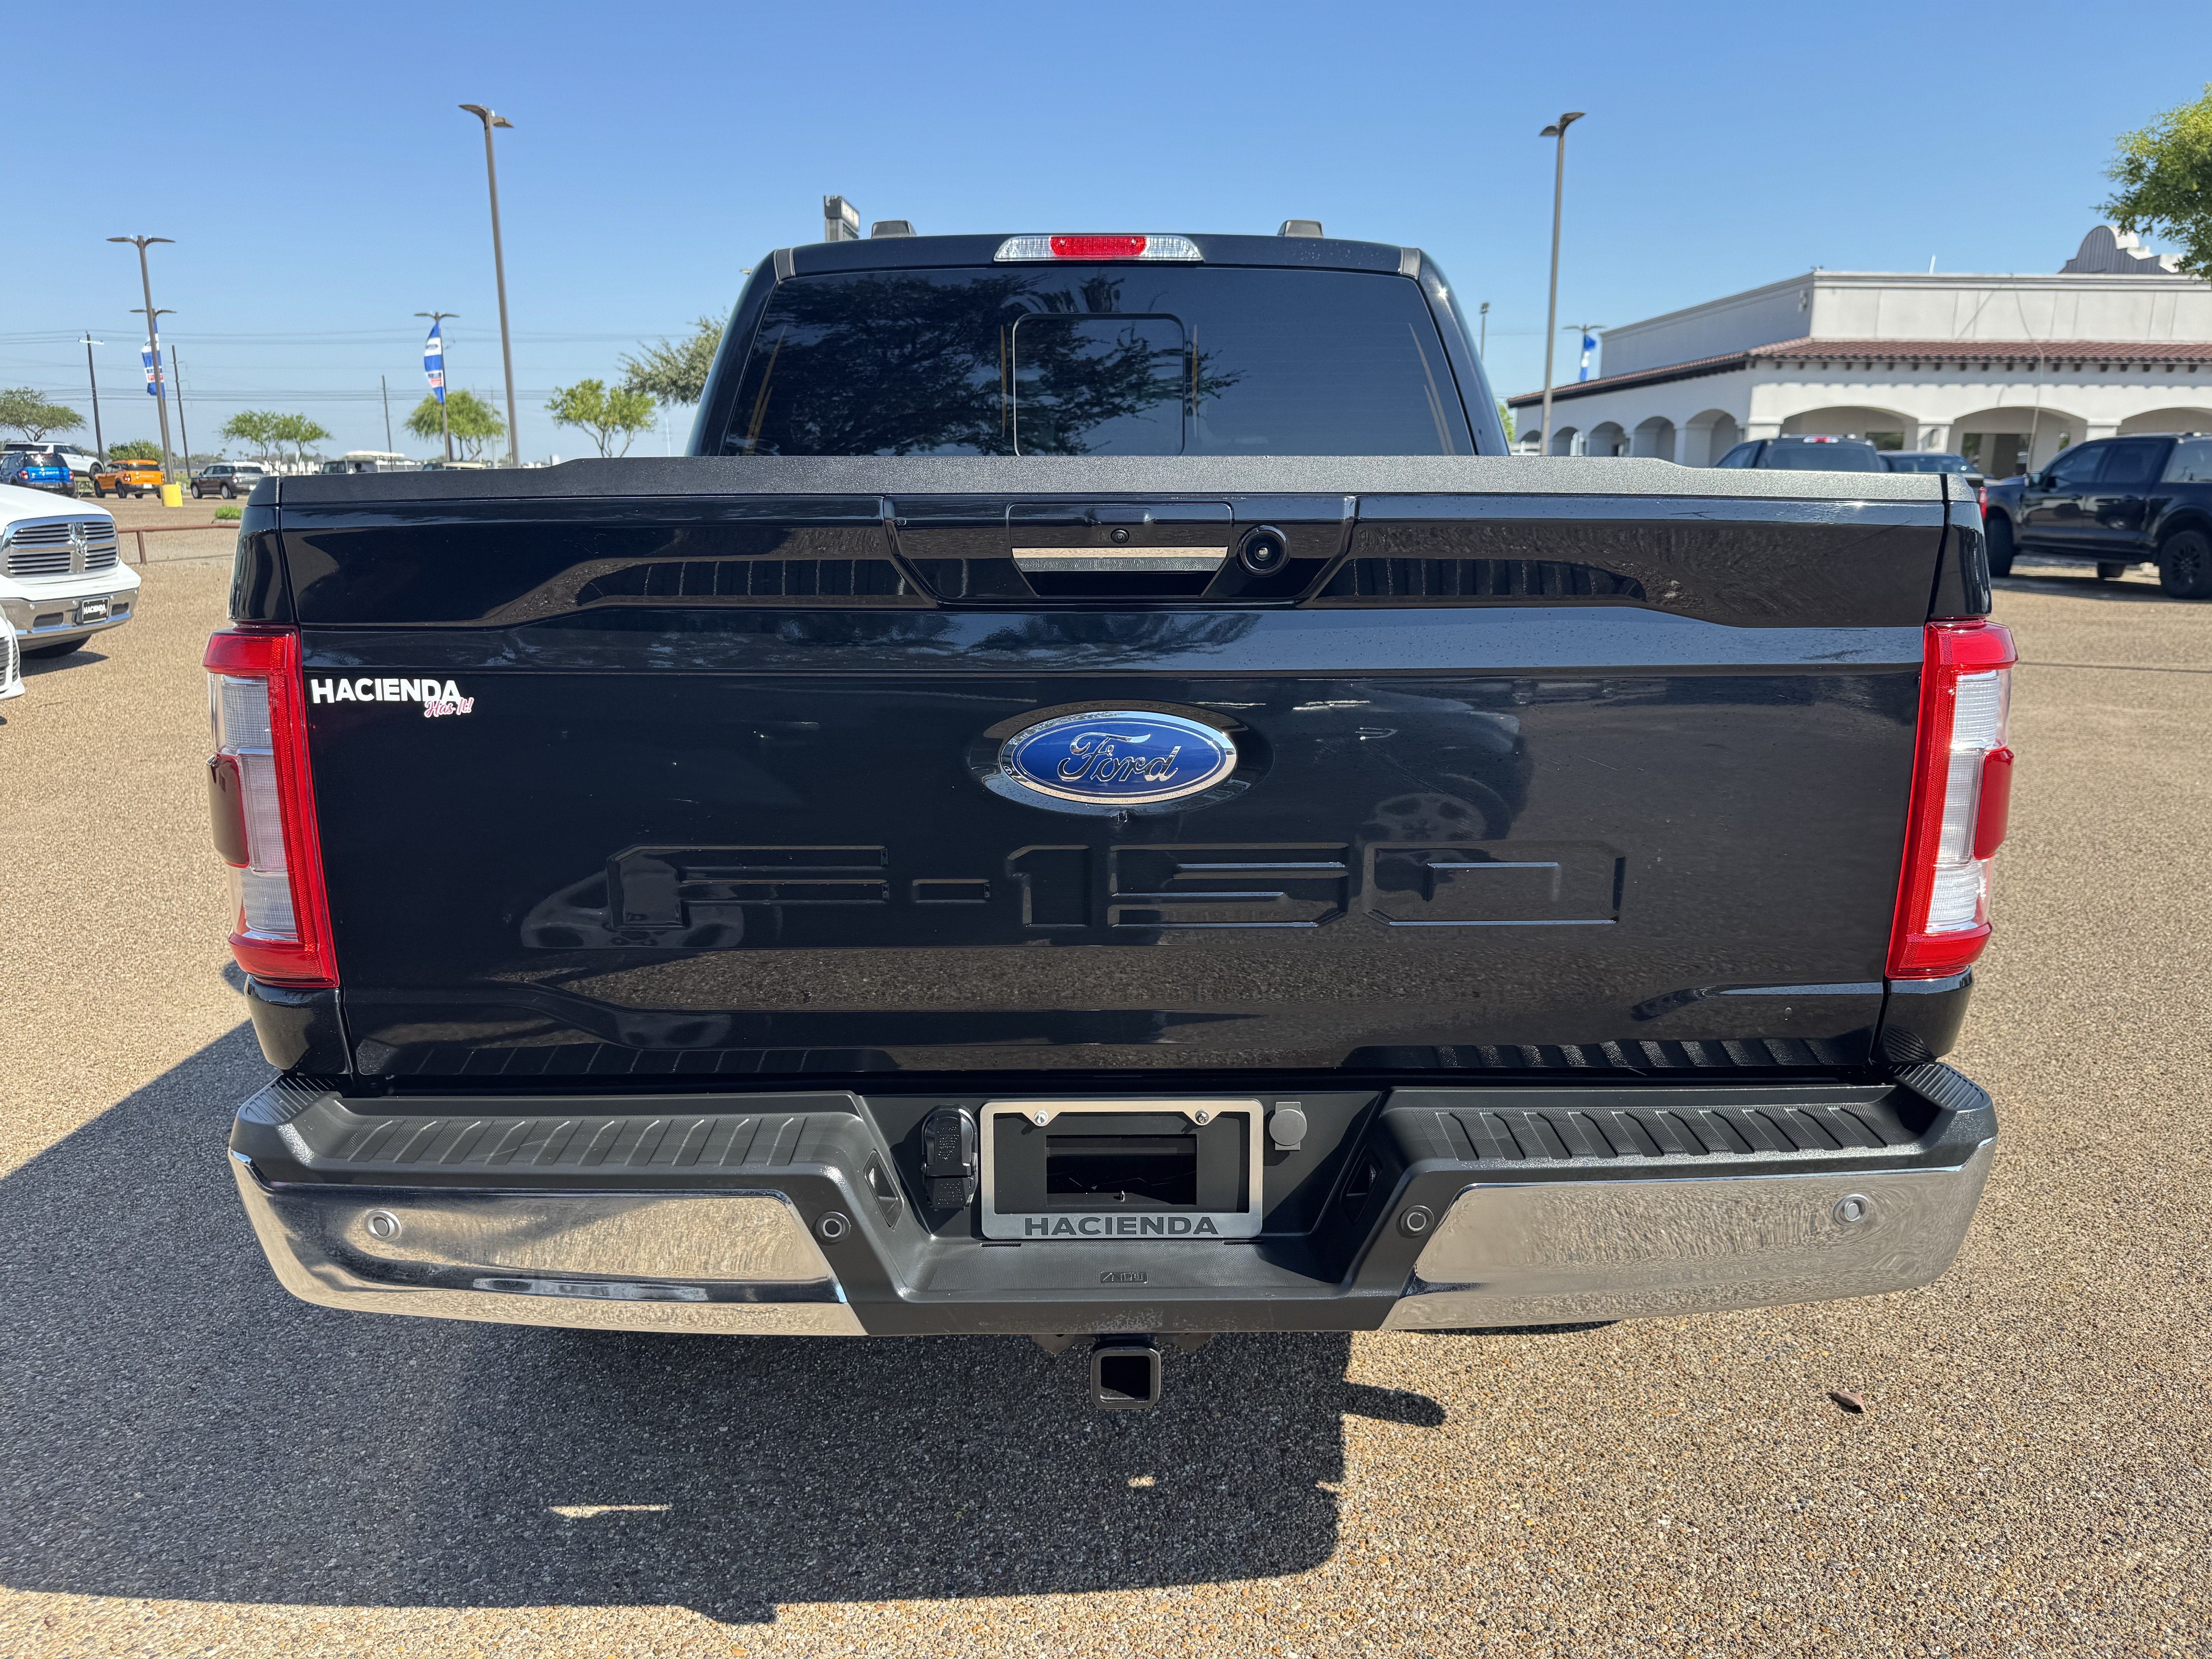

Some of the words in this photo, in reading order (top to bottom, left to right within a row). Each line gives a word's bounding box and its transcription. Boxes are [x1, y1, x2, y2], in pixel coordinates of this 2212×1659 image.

[311, 678, 462, 704] HACIENDA
[424, 701, 456, 718] Has
[456, 697, 474, 715] It!
[1057, 732, 1182, 781] Ford
[606, 842, 1627, 931] F-150
[1024, 1217, 1219, 1235] HACIENDA
